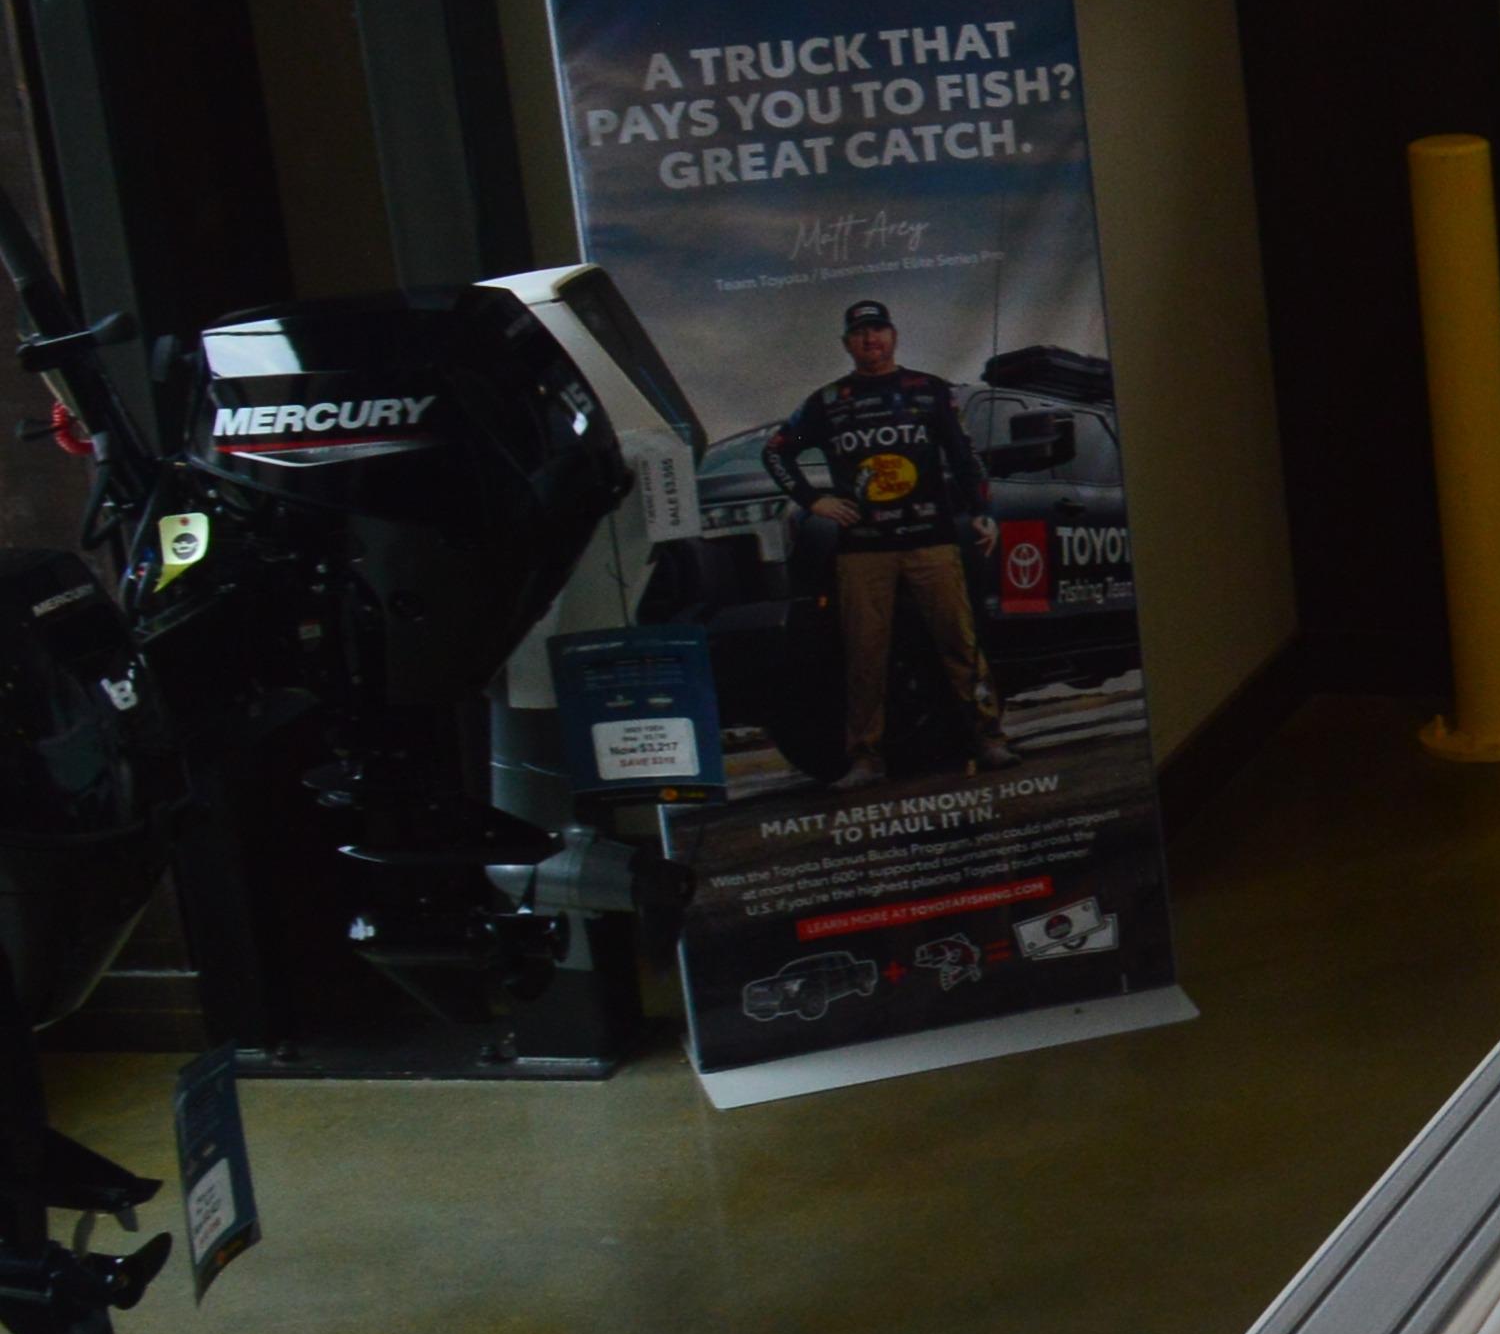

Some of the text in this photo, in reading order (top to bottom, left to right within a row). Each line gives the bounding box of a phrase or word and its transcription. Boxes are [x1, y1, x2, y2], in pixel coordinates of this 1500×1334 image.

[643, 20, 1016, 91] A TRUCK THAT
[586, 63, 1075, 147] PAYS YOU TO FISH?
[660, 119, 1032, 189] GREAT CATCH.
[212, 395, 437, 436] MERCURY
[829, 424, 929, 456] TOYOTA
[761, 775, 1060, 839] MATT AREY KNOWS HOW
[830, 806, 999, 845] TO HAUL IT IN.
[746, 871, 771, 884] the
[772, 862, 820, 879] Toyota
[821, 855, 866, 869] Bonus
[867, 848, 908, 862] Bucks
[1003, 822, 1041, 838] could
[758, 884, 795, 898] more
[797, 876, 830, 891] than
[868, 855, 940, 878] supported
[942, 844, 1028, 863] tournaments
[1030, 834, 1072, 850] across
[1073, 830, 1096, 842] the
[831, 888, 856, 901] the
[856, 878, 909, 898] highest
[911, 871, 962, 891] placing
[963, 862, 1009, 879] Toyota
[806, 881, 1044, 935] LEARN MORE AT TOYOTAFISHING.COM
